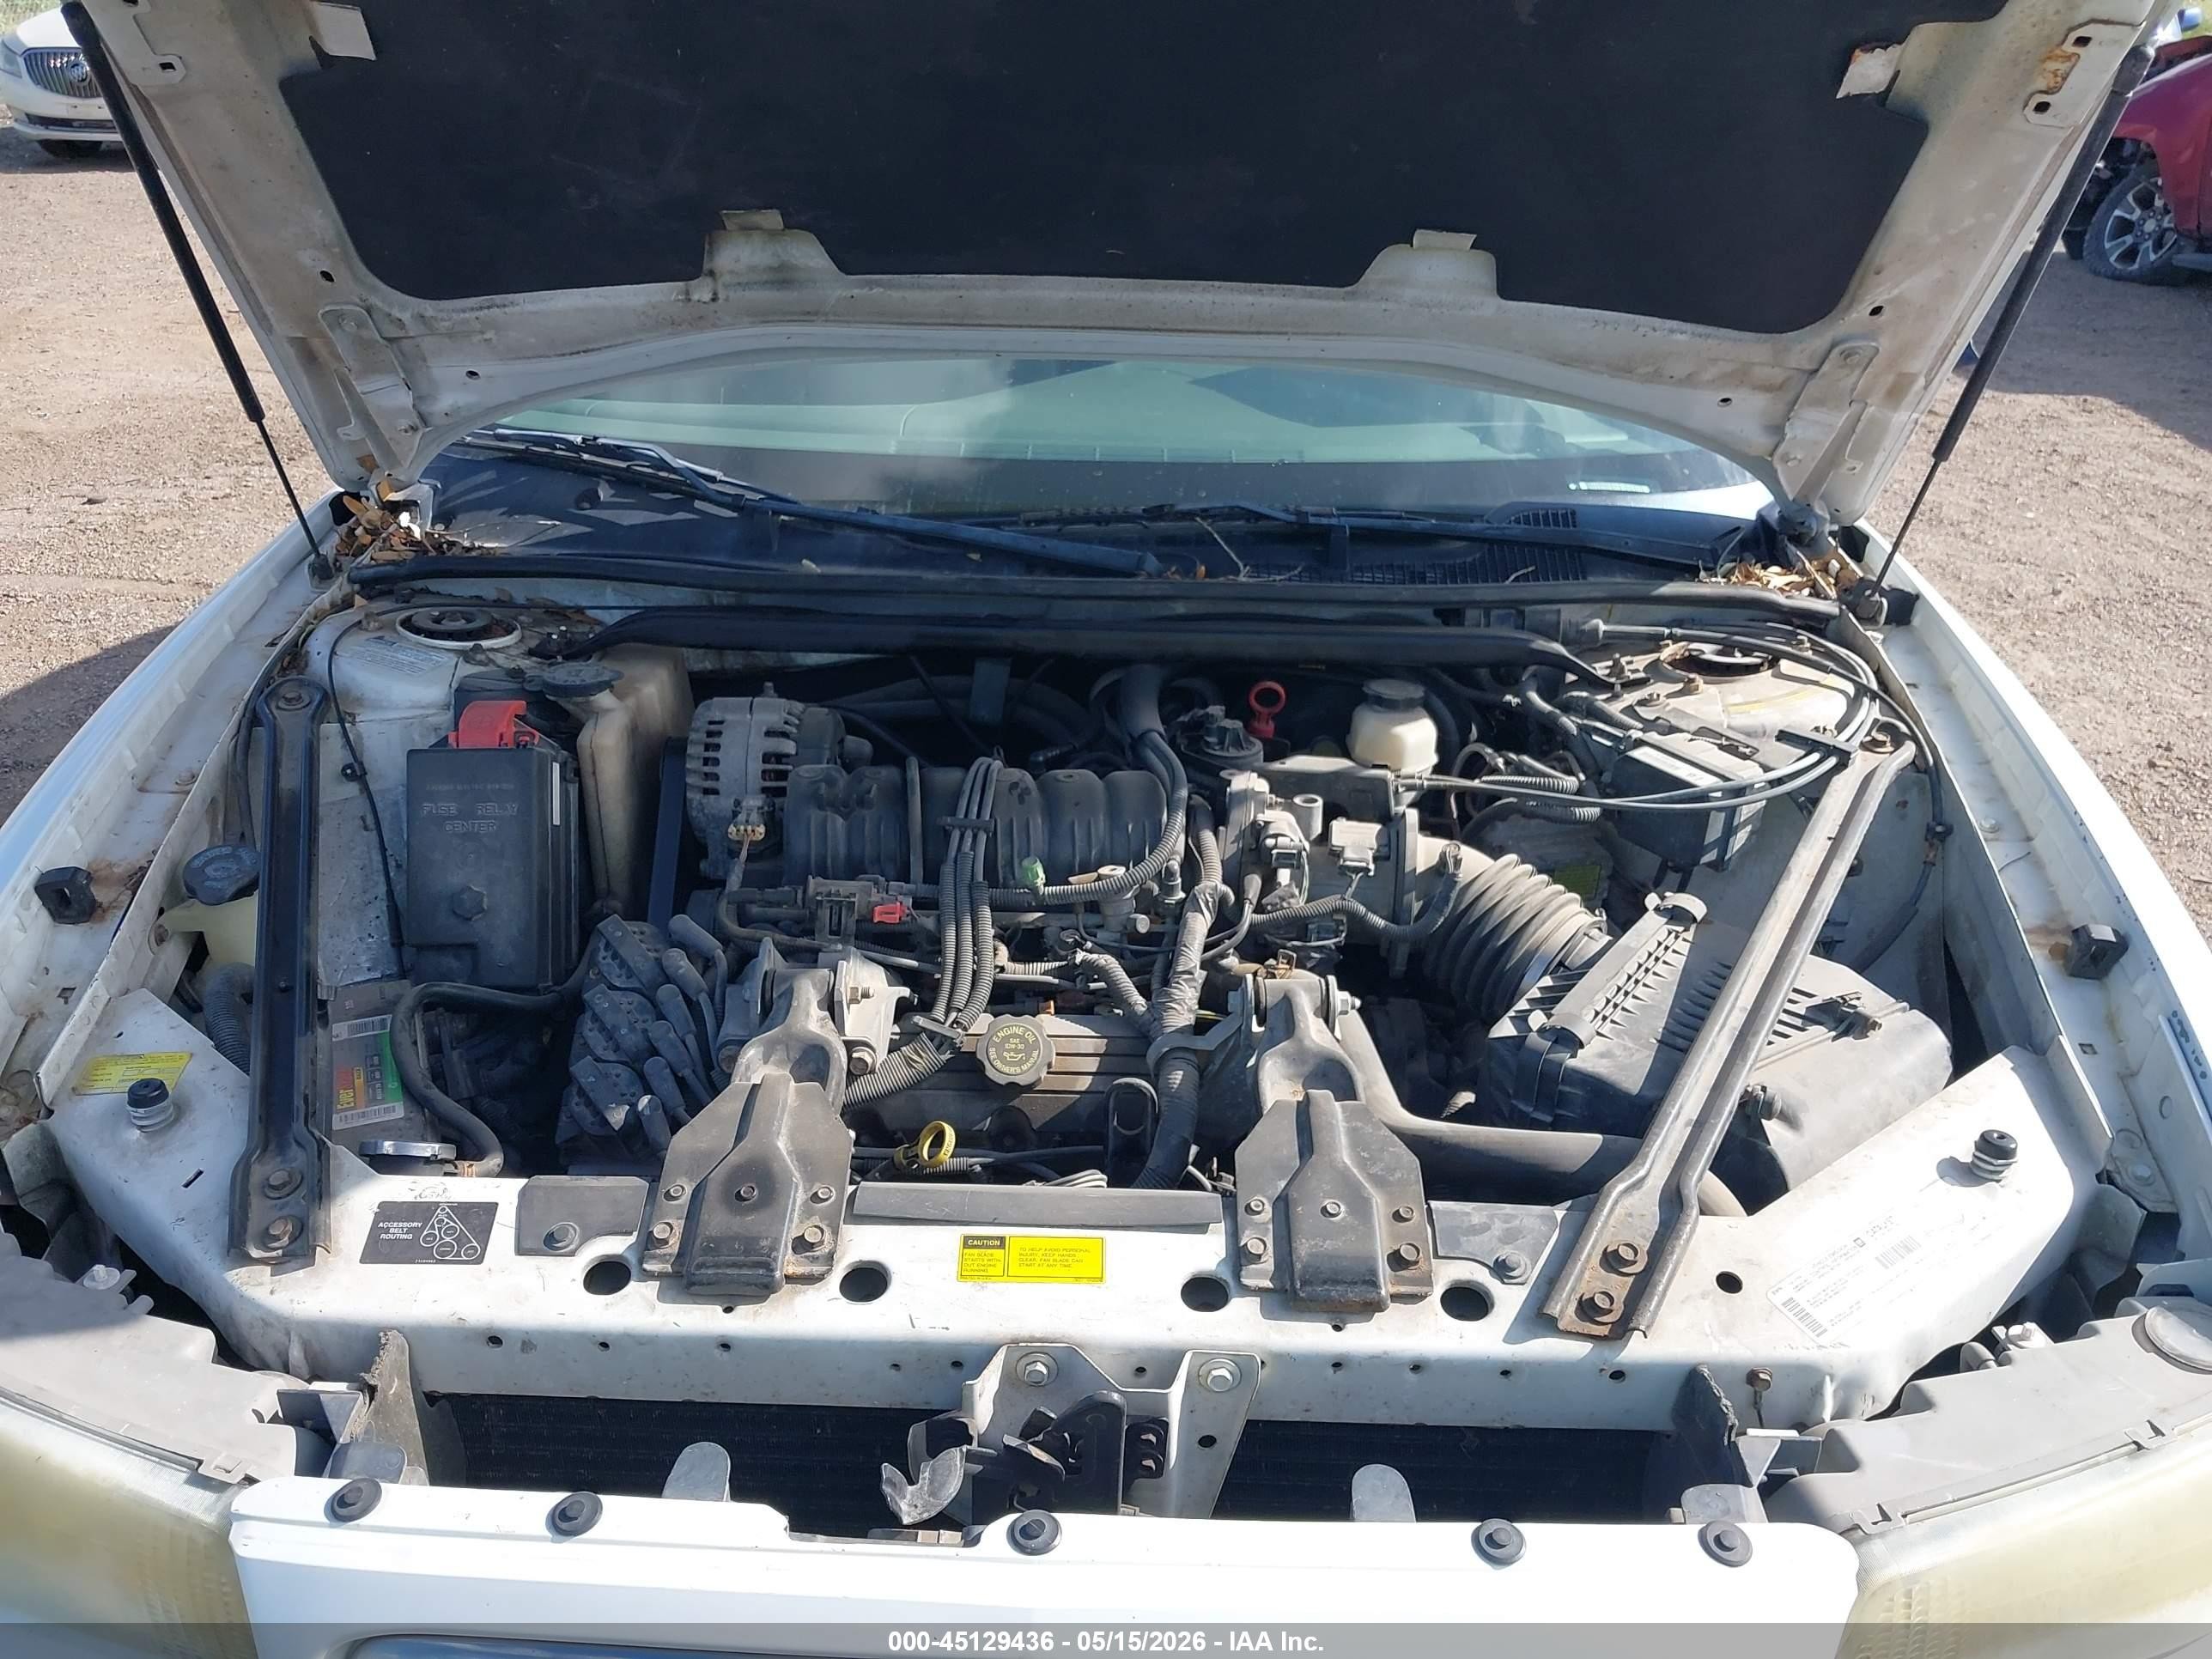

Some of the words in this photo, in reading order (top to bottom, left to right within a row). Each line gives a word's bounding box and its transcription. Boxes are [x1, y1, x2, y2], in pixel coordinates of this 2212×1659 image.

[422, 803, 460, 816] FUSE
[476, 803, 519, 816] RELAY
[443, 820, 497, 833] CENTER
[993, 1026, 1025, 1042] ENGINE
[1024, 1031, 1036, 1044] OIL
